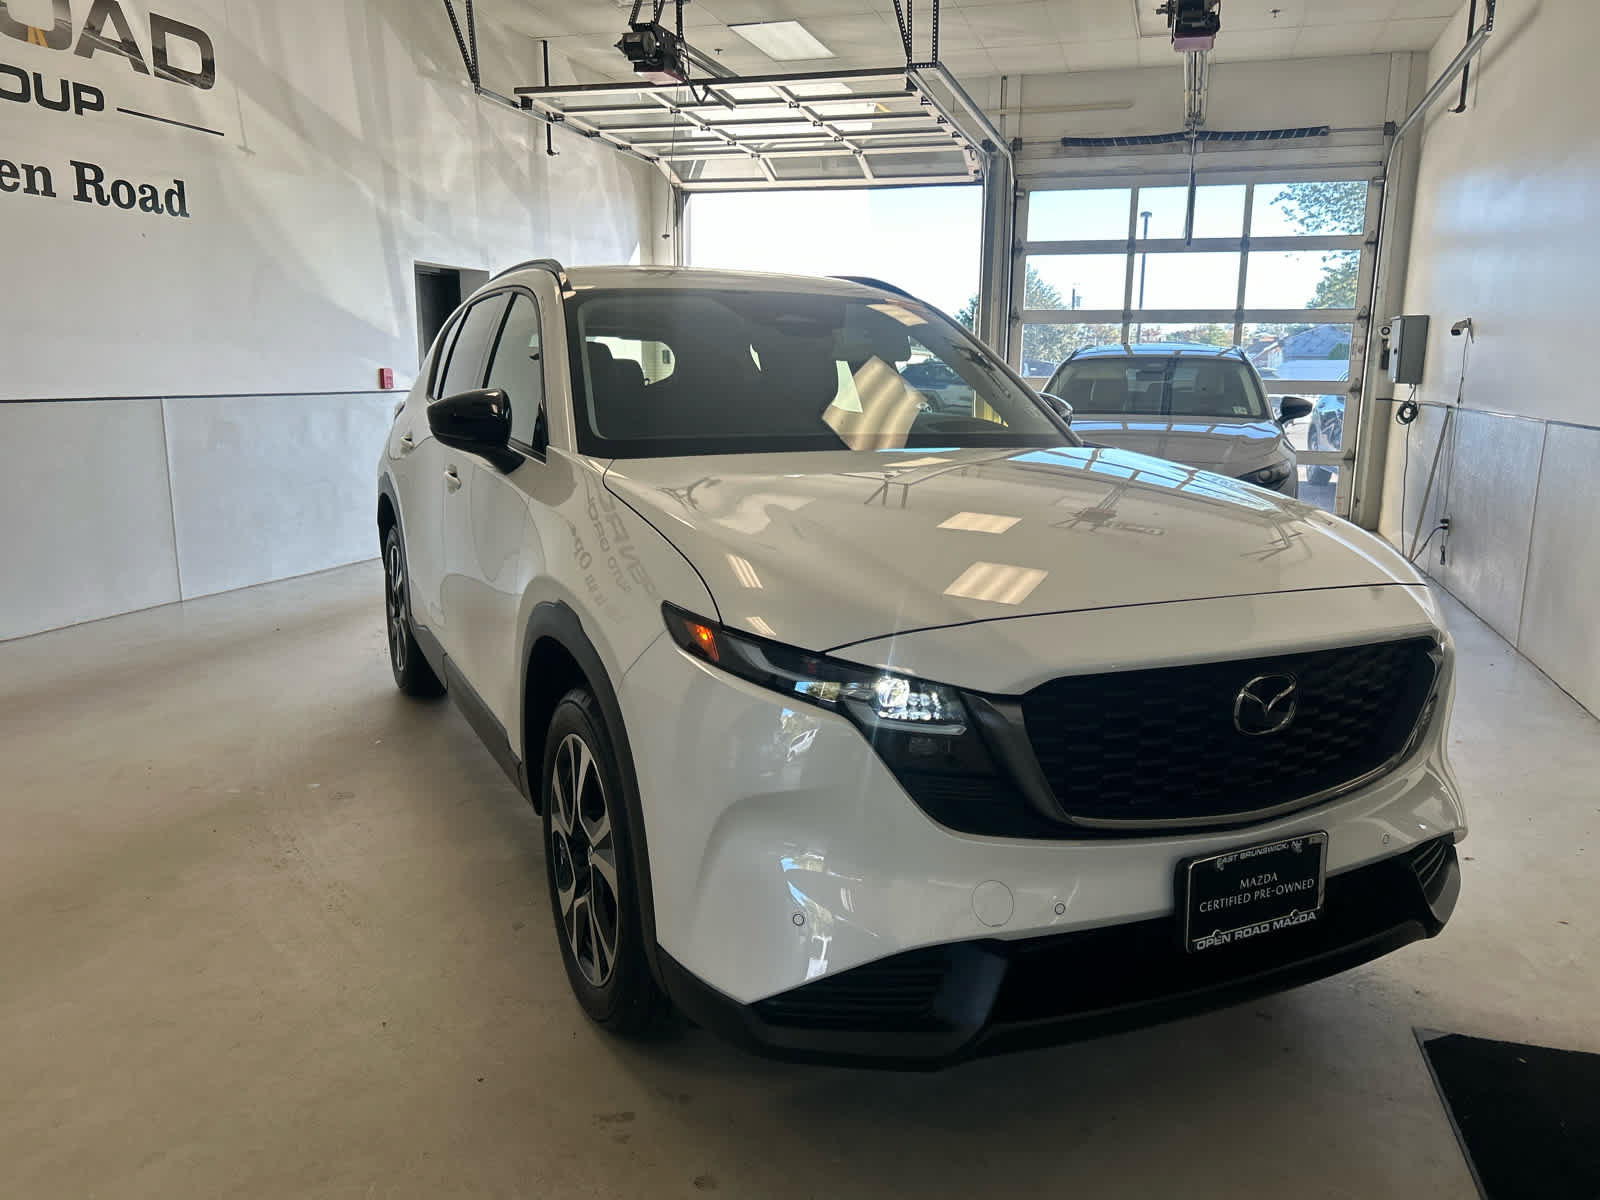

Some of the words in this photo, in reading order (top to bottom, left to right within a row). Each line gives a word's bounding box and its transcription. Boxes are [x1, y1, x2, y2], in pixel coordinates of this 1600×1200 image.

[0, 63, 105, 116] OUP
[69, 160, 190, 218] Road
[1199, 892, 1252, 913] CERTIFIED
[1254, 878, 1314, 901] PRE-OWNED
[1240, 871, 1278, 889] MAZDA
[1196, 933, 1231, 951] OPEN
[1234, 923, 1270, 941] ROAD
[1272, 911, 1317, 930] MAZDA
